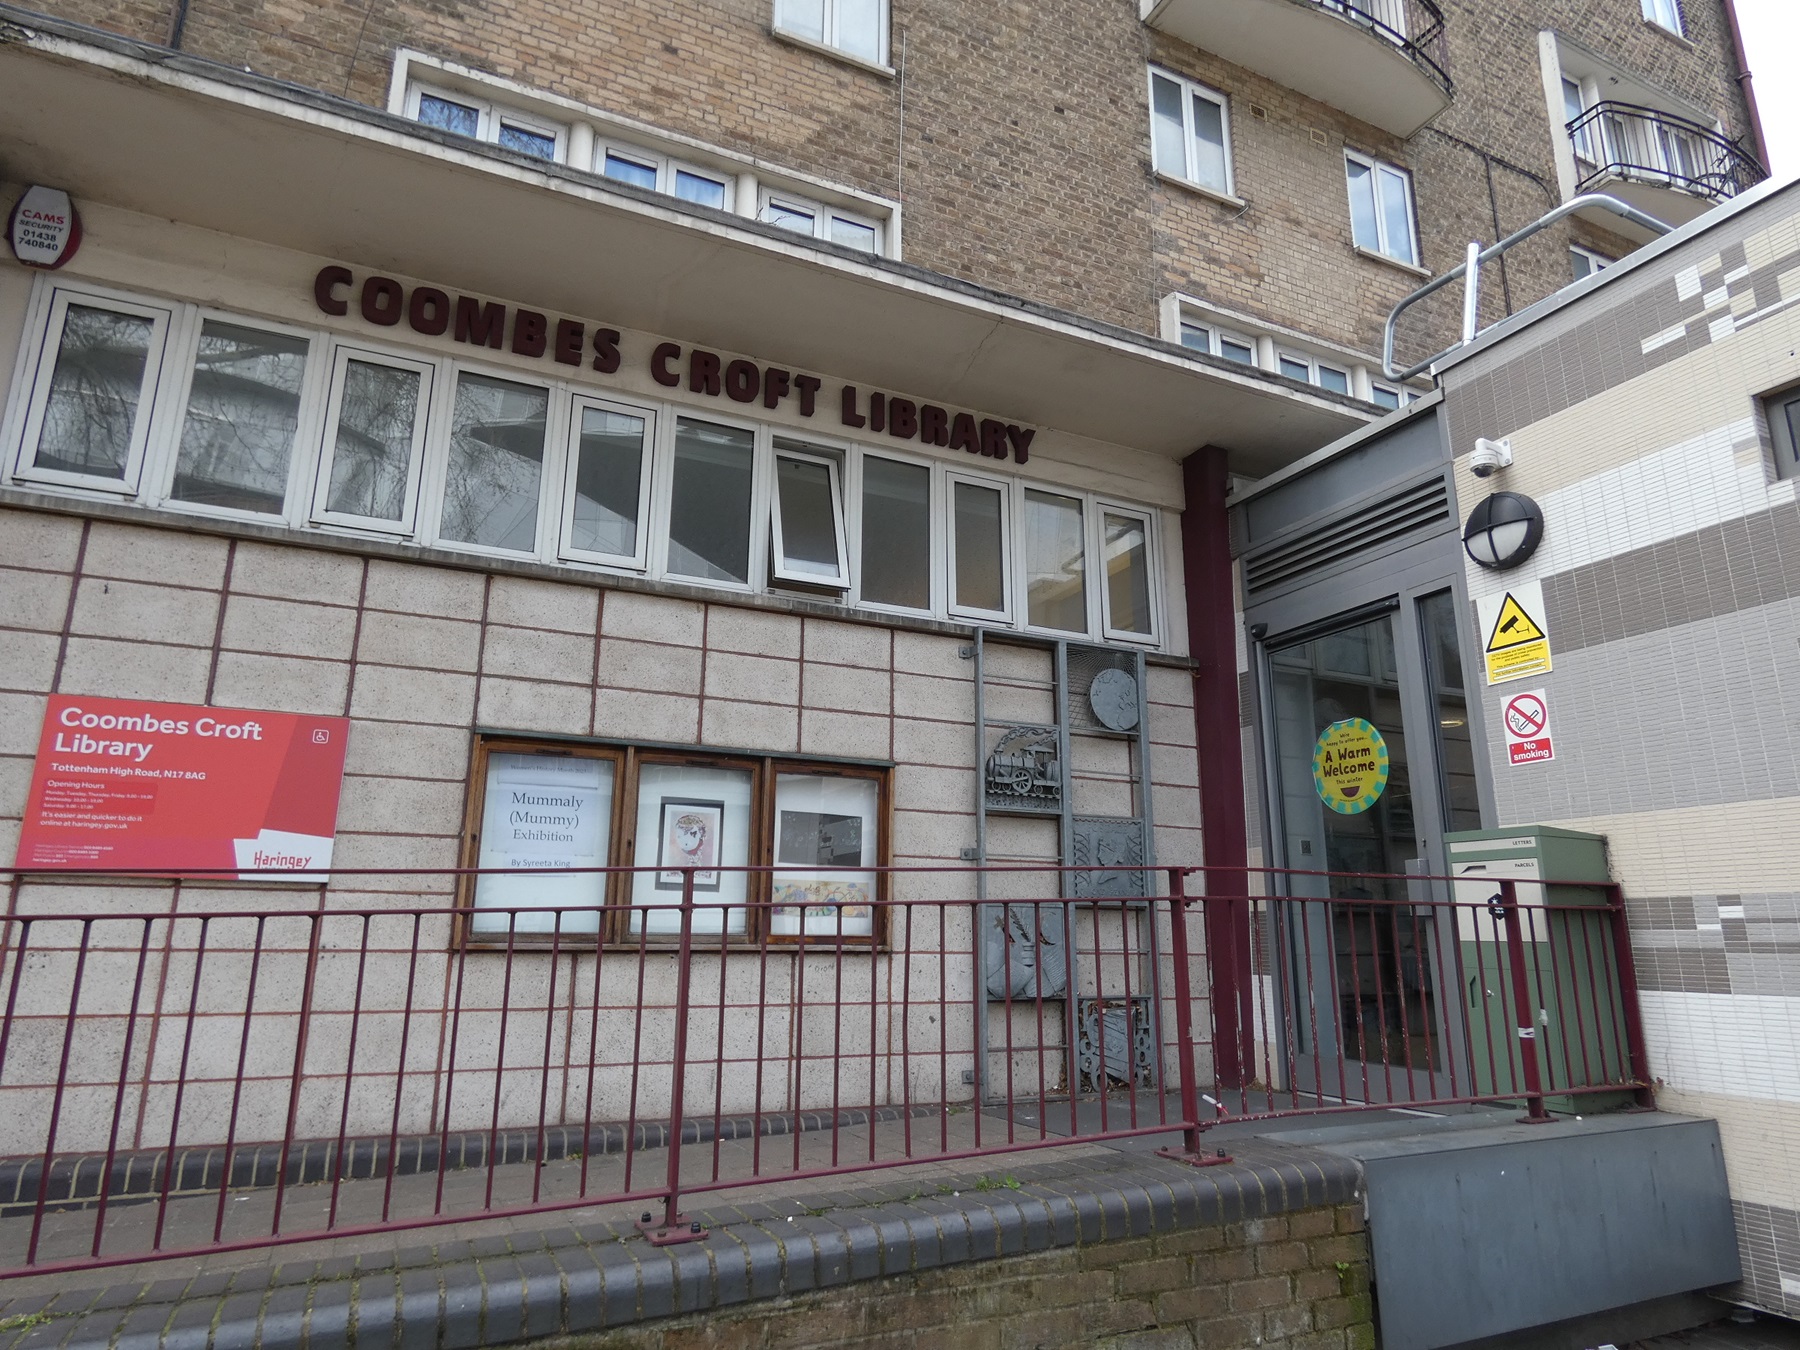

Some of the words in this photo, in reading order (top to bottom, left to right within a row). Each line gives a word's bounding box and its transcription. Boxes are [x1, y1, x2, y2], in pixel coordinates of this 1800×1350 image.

[22, 209, 65, 225] CAMS
[19, 220, 64, 233] SECURITY
[23, 229, 57, 242] 01438
[18, 237, 58, 251] 740840
[314, 266, 621, 374] COOMBES
[651, 342, 821, 418] CROFT
[841, 386, 1036, 465] LIBRARY
[61, 707, 189, 735] Coombes
[195, 717, 262, 740] Croft
[55, 732, 153, 762] Library
[1523, 742, 1536, 751] No
[1325, 750, 1333, 763] A
[1338, 747, 1371, 761] Warm
[1513, 749, 1549, 761] smoking
[51, 762, 108, 774] Tottenham
[110, 766, 133, 777] High
[135, 768, 162, 778] Road,
[164, 770, 184, 779] N17
[185, 771, 206, 780] 8AG
[1323, 761, 1375, 777] Welcome
[47, 780, 80, 789] Opening
[512, 792, 583, 811] Mummaly
[72, 821, 128, 829] haringey.gov.uk
[509, 811, 579, 829] (Mummy)
[513, 829, 573, 842] Exhibition
[254, 850, 312, 869] Haringey
[511, 859, 521, 867] By
[523, 859, 552, 867] Syreeta
[554, 860, 571, 868] King
